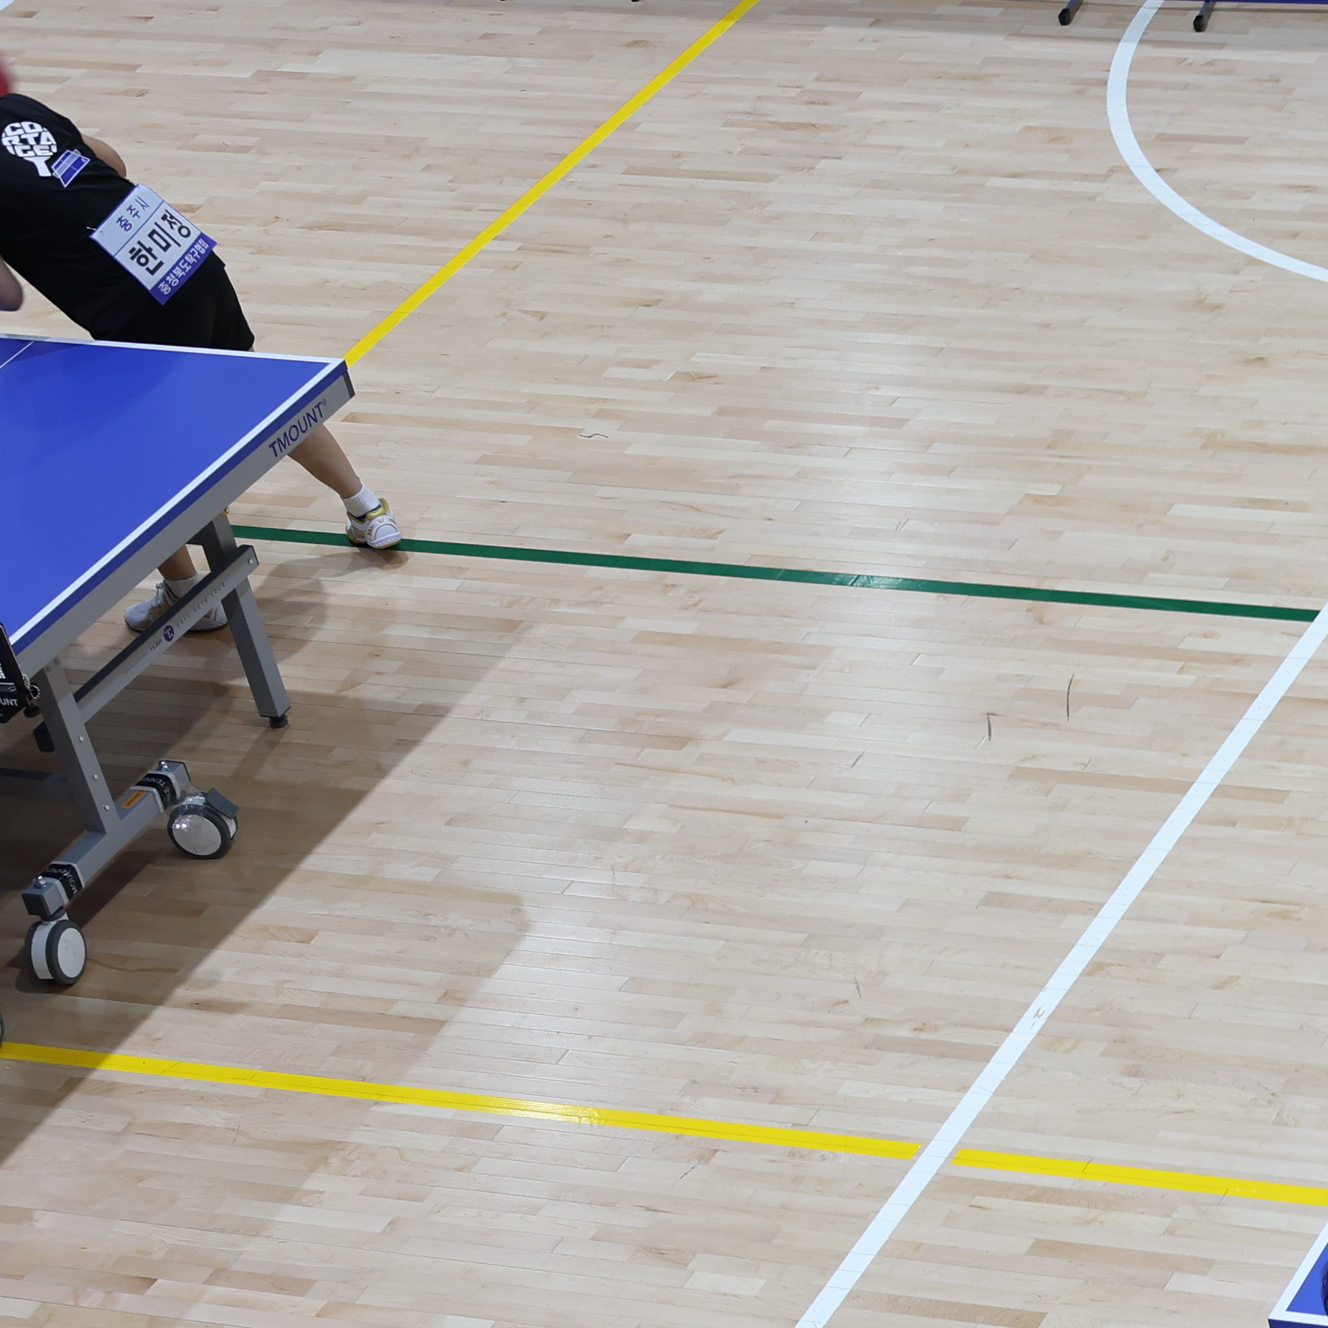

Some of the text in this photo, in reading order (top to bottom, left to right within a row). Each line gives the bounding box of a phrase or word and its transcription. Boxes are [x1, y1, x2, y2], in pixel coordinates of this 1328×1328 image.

[116, 196, 150, 232] 충주시
[128, 209, 191, 276] 한미정
[158, 238, 210, 295] 충청북도탁구협회
[268, 402, 324, 458] TMOUNT
